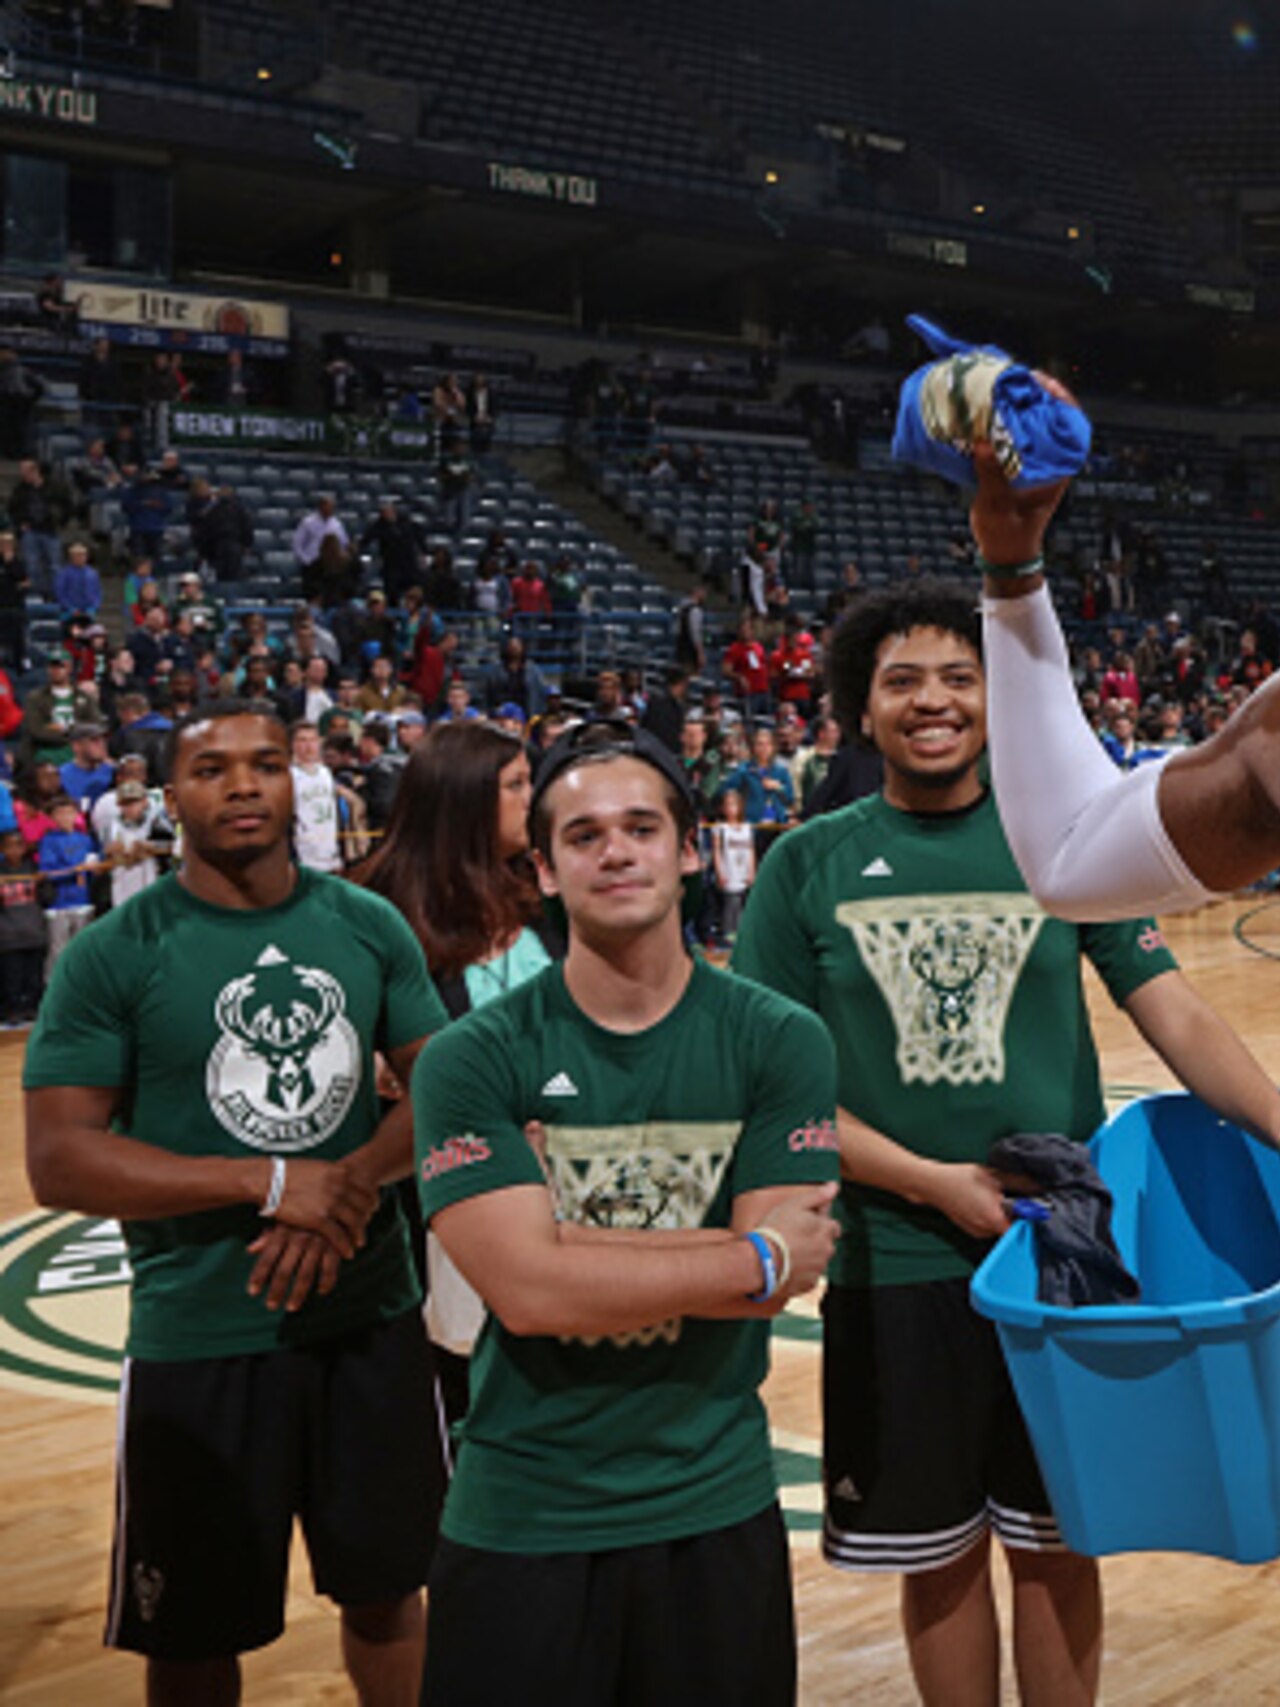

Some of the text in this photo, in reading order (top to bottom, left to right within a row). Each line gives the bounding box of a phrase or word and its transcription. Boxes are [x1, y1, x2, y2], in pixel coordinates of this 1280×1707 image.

[36, 84, 97, 124] YOU
[486, 162, 597, 206] THANK YOU
[934, 240, 967, 267] YOU
[172, 411, 235, 437] RENEW
